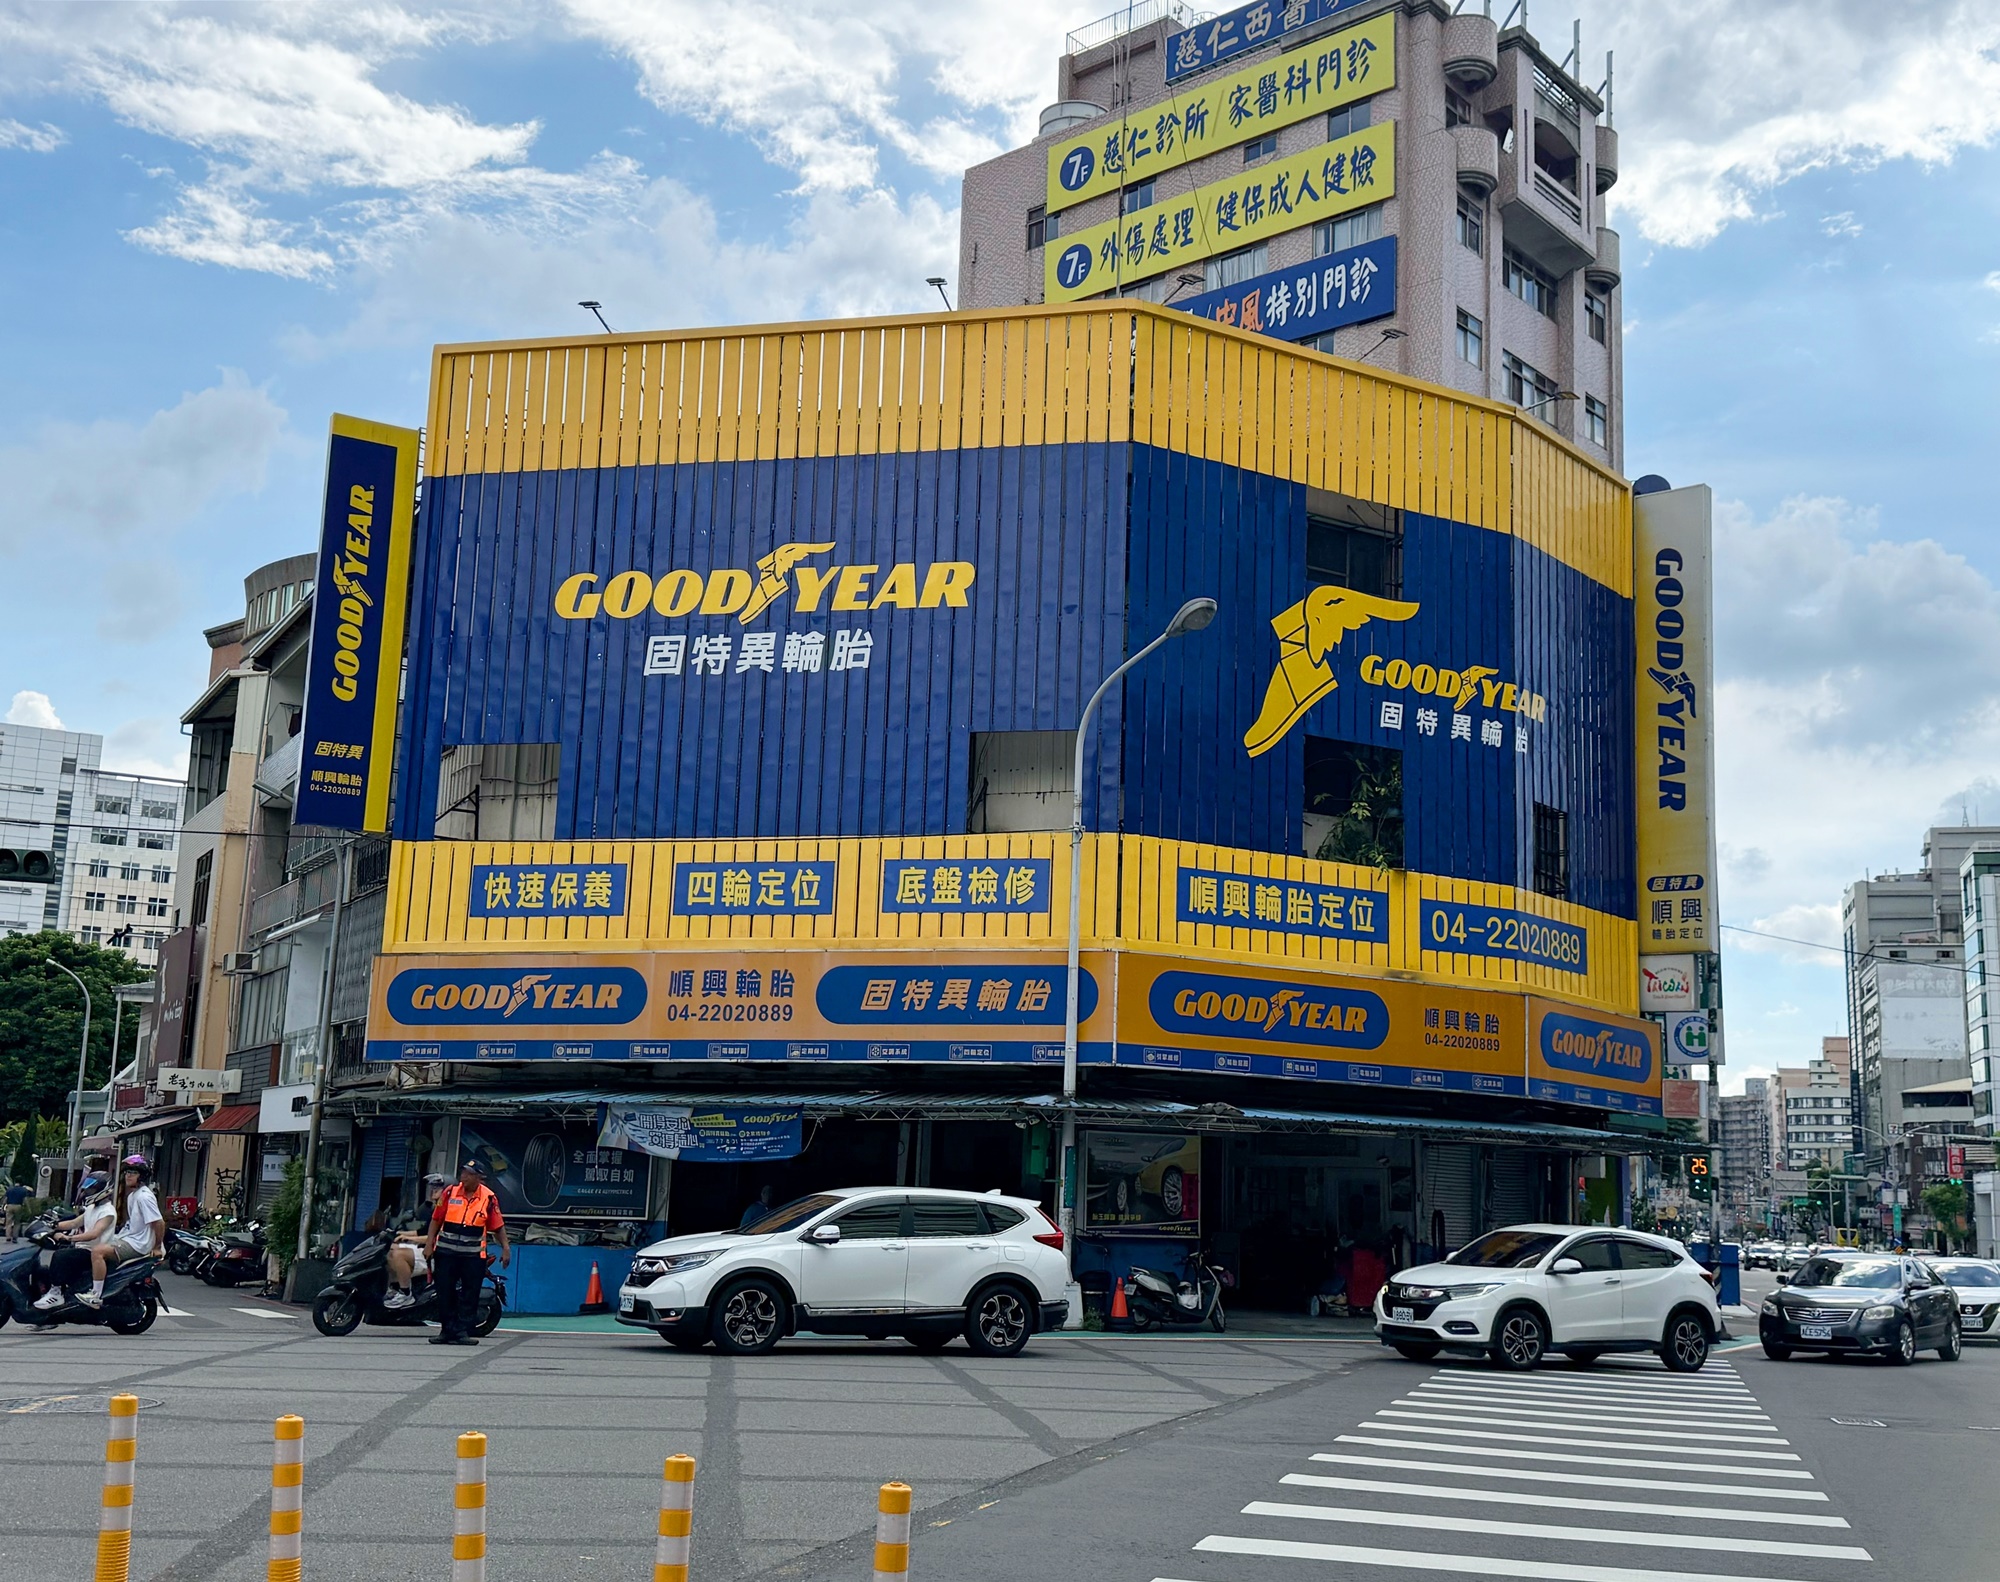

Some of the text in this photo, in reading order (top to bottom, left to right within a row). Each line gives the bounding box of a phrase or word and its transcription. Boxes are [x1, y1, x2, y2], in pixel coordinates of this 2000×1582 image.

[331, 485, 374, 702] GOODYEAR
[554, 552, 976, 622] GOODYEAR
[643, 628, 874, 677] 固特異輪胎
[1360, 655, 1546, 723] GOODYEAR
[1653, 547, 1687, 812] GOODYEAR
[1380, 701, 1528, 755] 固特異輪胎
[314, 741, 365, 760] 固特異
[311, 769, 363, 787] 順興輪胎
[484, 871, 613, 910] 快速保養
[687, 868, 821, 908] 四輪定位
[895, 866, 1036, 905] 底盤檢修
[1651, 876, 1699, 891] 固特異
[1189, 875, 1374, 933] 順興輪胎定位
[1651, 898, 1703, 925] 順興
[1431, 909, 1581, 965] 04-22020889
[1652, 927, 1704, 940] 輪胎定位
[411, 977, 622, 1016] GOODYEAR
[668, 969, 796, 998] 順興輪胎
[860, 978, 1051, 1012] 固特異輪胎
[667, 1003, 793, 1022] 04-22020889
[1174, 988, 1368, 1033] GOODYEAR
[1424, 1008, 1500, 1035] 順興輪胎
[1424, 1034, 1500, 1052] 04-22020889
[1552, 1029, 1642, 1067] GOODYEAR
[743, 1112, 799, 1125] GOODYEAR
[573, 1150, 623, 1165] 全面掌握
[584, 1167, 635, 1183] 駕馭自如
[1691, 1158, 1708, 1174] 25
